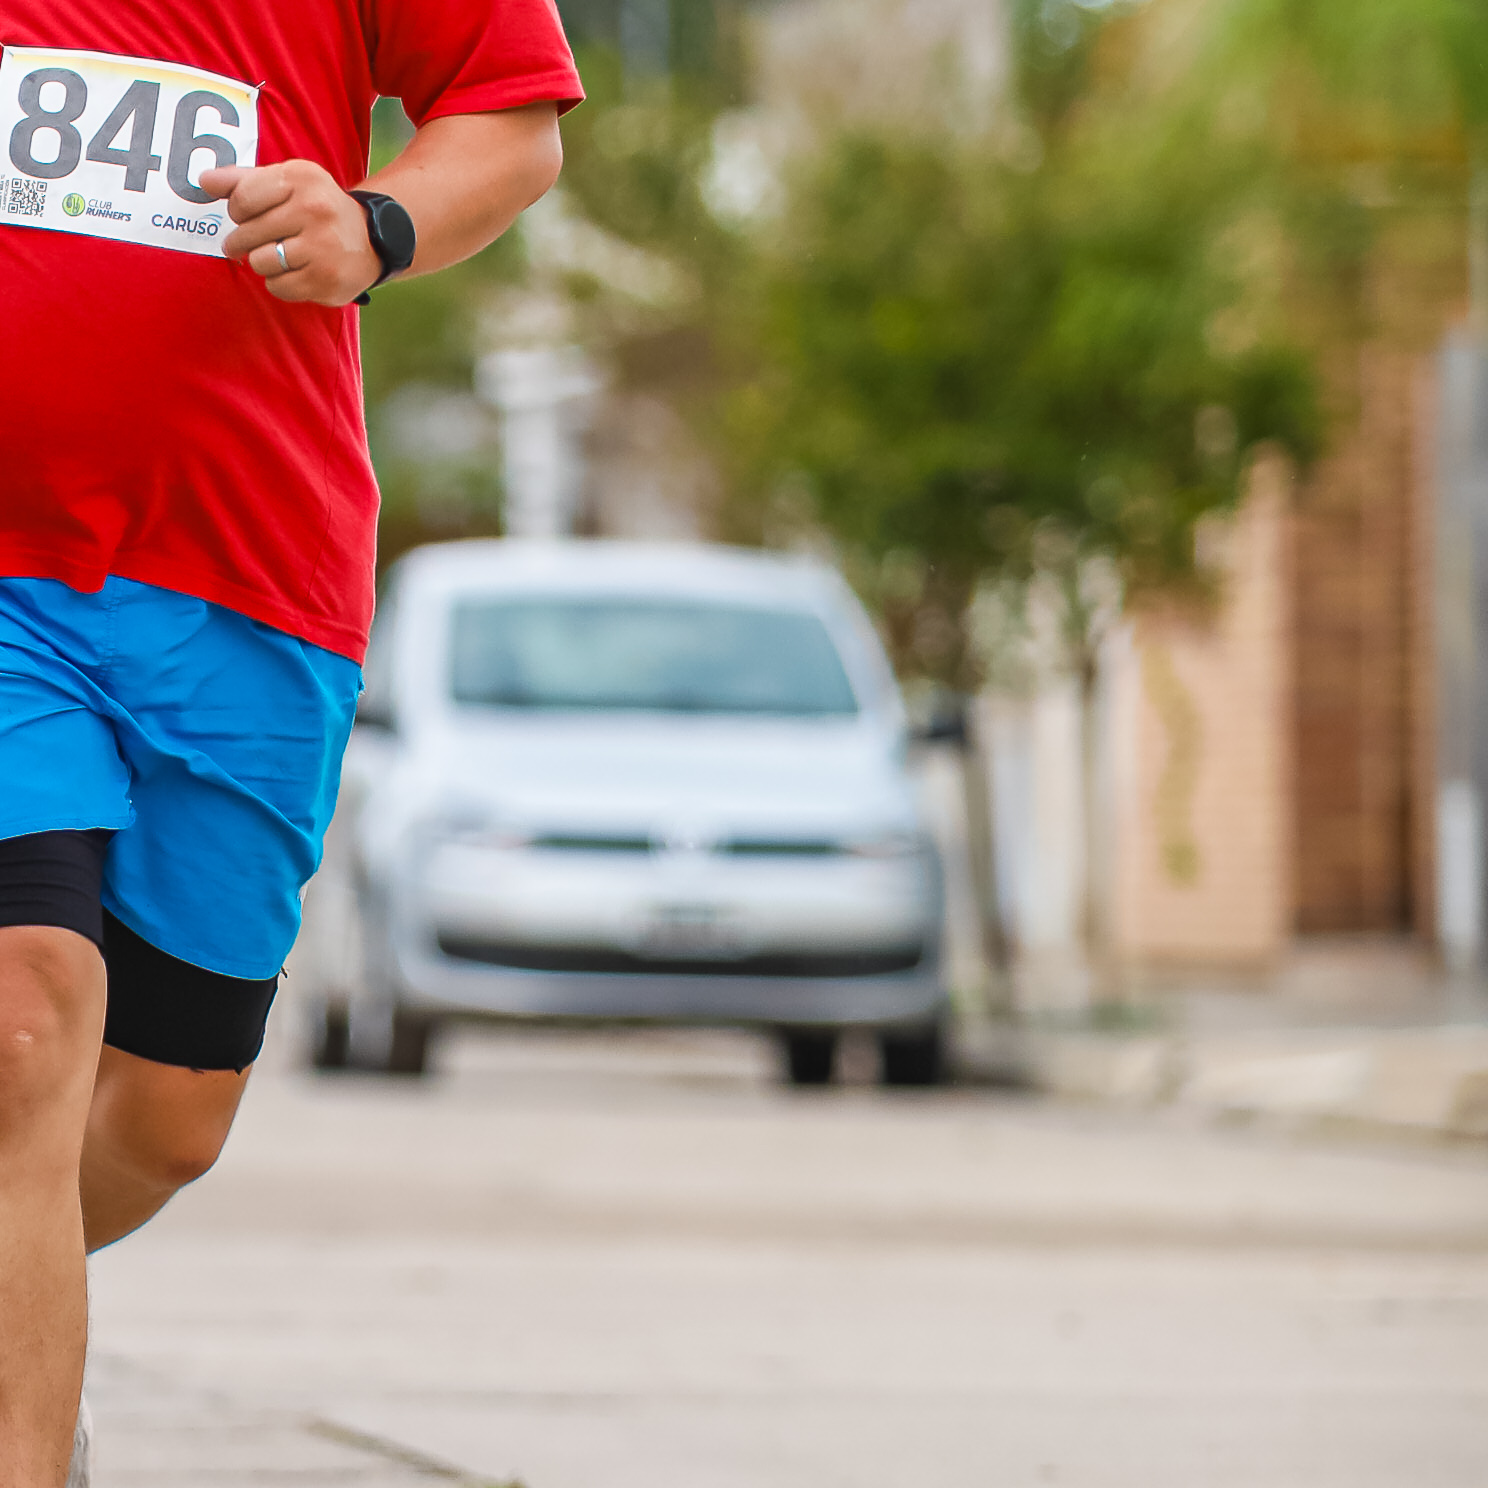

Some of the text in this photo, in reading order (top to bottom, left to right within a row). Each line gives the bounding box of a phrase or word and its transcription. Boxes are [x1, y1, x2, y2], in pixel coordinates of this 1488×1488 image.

[9, 67, 240, 204] 846
[88, 198, 113, 210] CLUB
[85, 207, 132, 222] RUNNER'S
[151, 213, 219, 237] CARUSO
